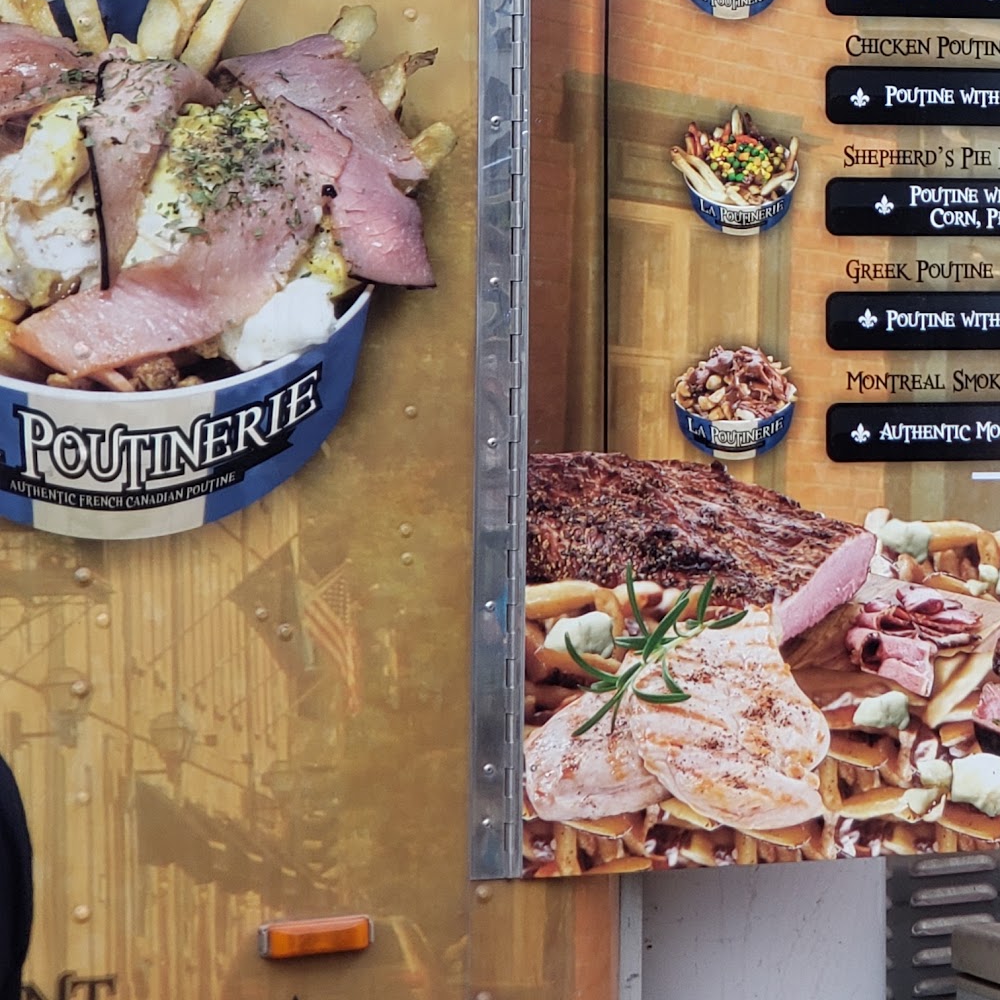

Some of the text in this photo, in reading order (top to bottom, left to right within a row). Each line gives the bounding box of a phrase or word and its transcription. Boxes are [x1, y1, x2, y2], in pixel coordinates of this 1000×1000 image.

[845, 34, 931, 58] CHICKEN
[885, 85, 954, 109] POUTINE
[960, 88, 999, 108] WITH
[843, 145, 954, 169] SHEPHERD'S
[960, 147, 991, 168] PIE
[910, 186, 978, 207] POUTINE
[930, 208, 981, 228] CORN,
[846, 259, 994, 284] GREEK POUTINE
[886, 310, 955, 331] POUTINE
[961, 311, 1000, 331] WITH
[846, 371, 945, 394] MONTREAL
[16, 369, 320, 492] POUTINERIE
[879, 421, 971, 444] AUTHENTIC
[10, 471, 236, 508] AUTHENTIC FRENCH CANADIAN POUTINE
